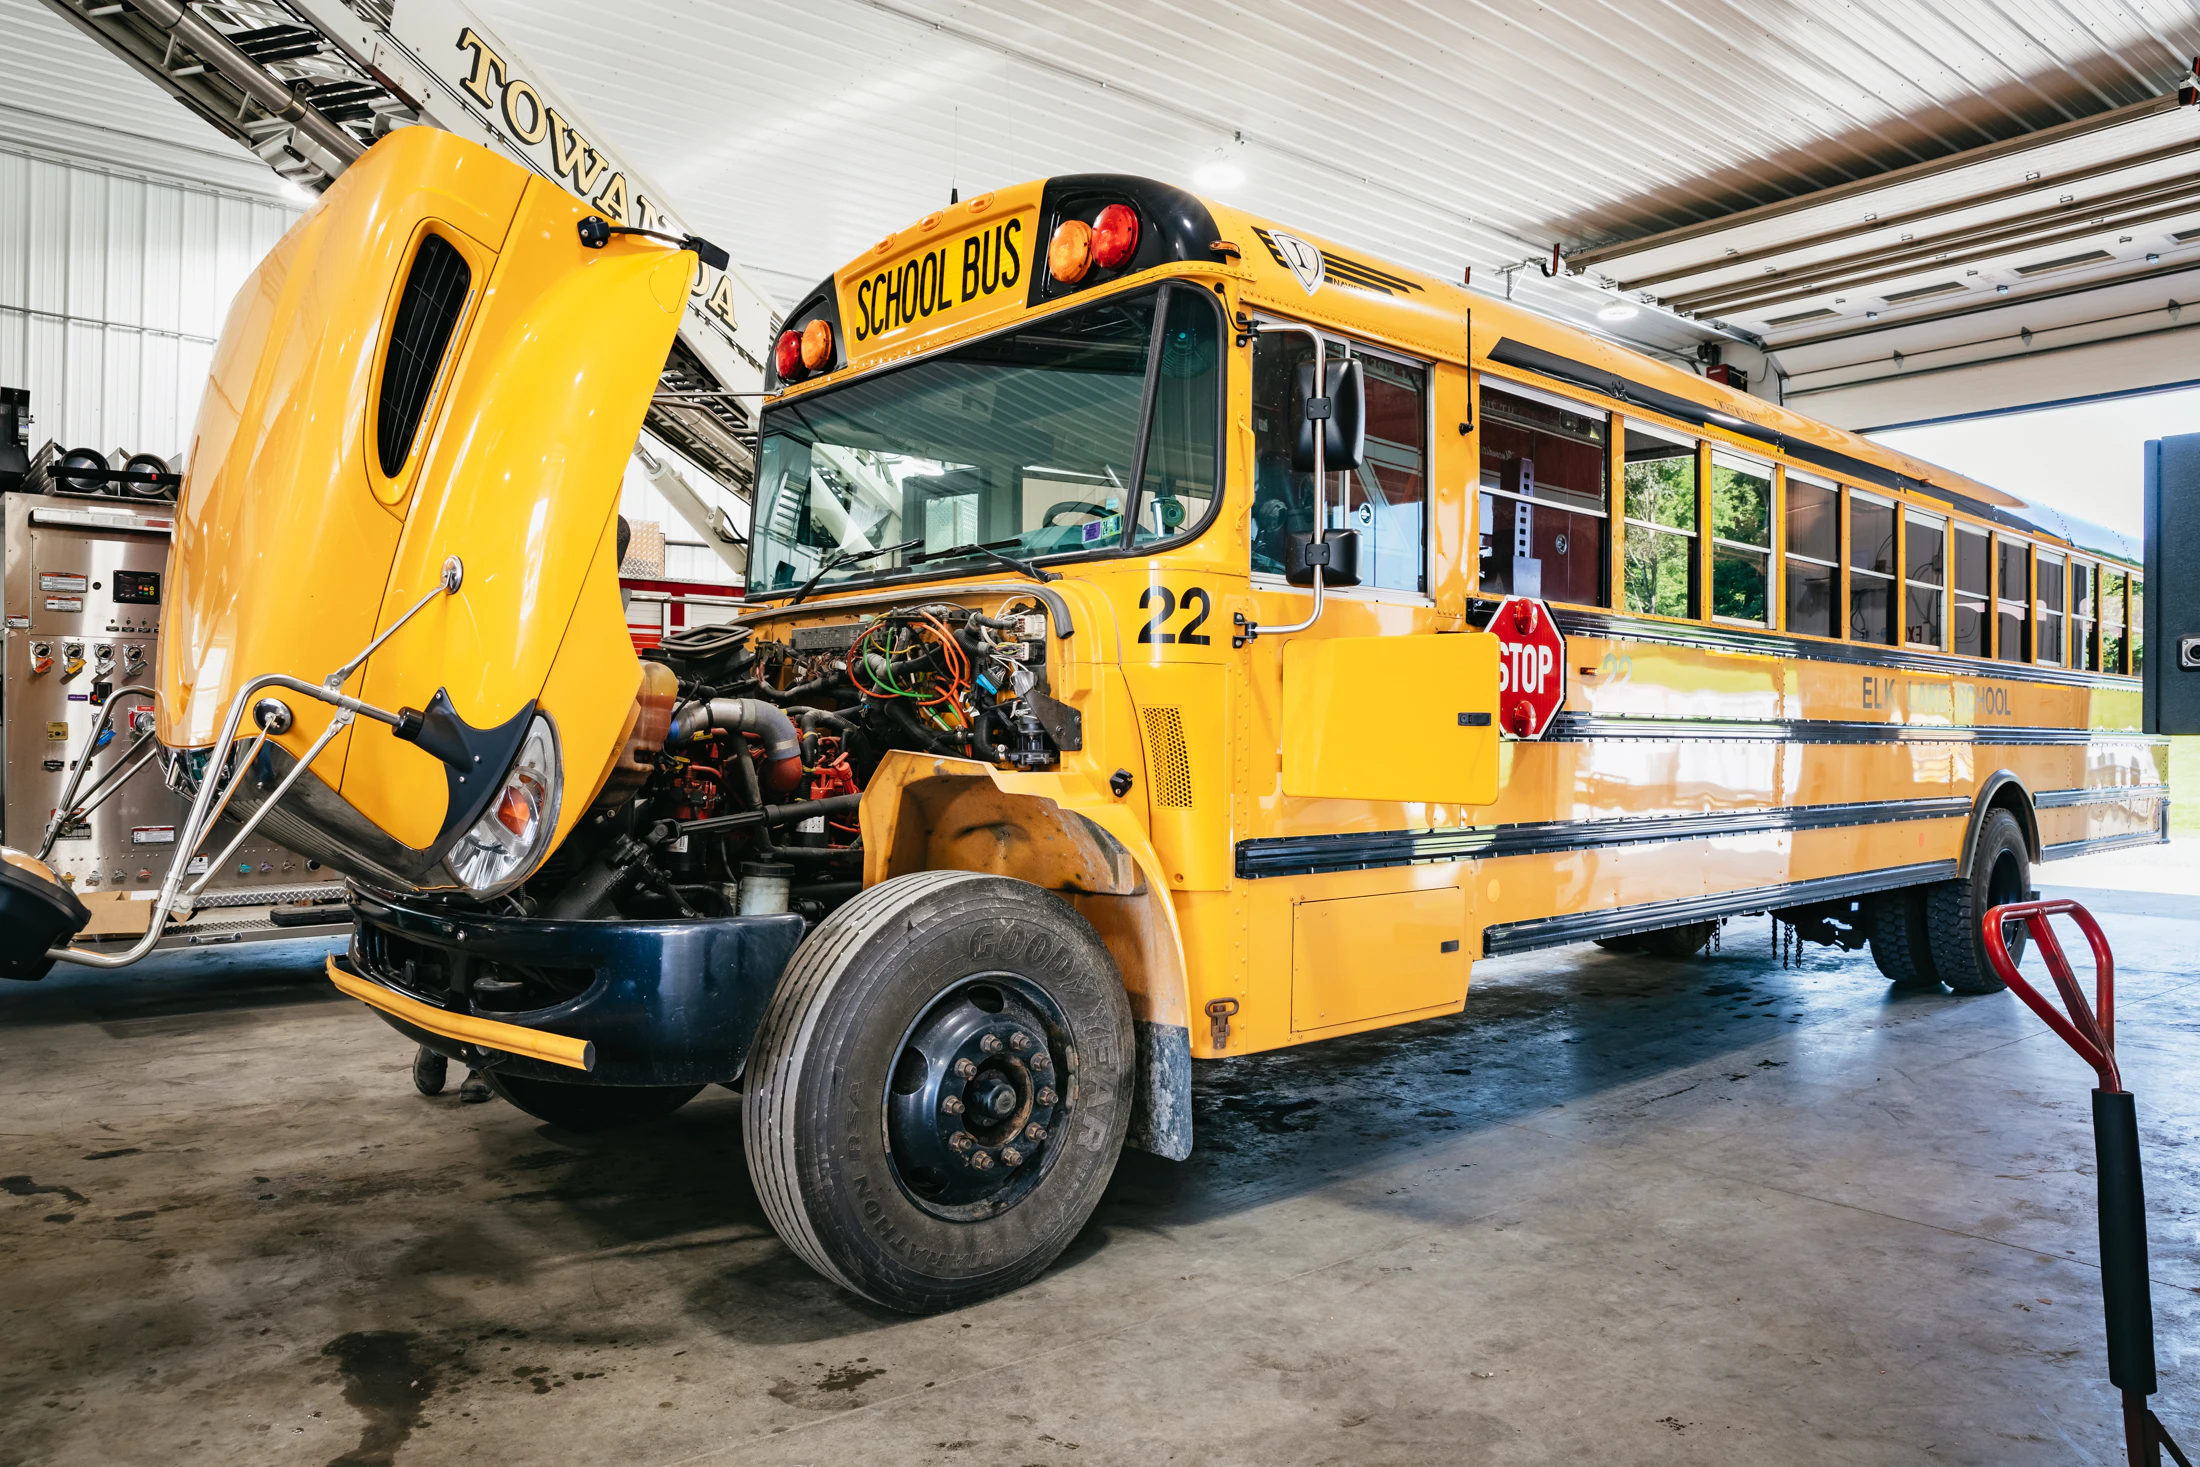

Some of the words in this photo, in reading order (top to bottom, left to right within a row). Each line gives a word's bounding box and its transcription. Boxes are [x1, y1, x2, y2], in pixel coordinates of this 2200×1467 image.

[856, 248, 952, 341] SCHOOL
[962, 218, 1021, 303] BUS
[1137, 585, 1211, 646] 22
[1500, 641, 1554, 694] STOP
[1603, 653, 1633, 691] 22
[1862, 676, 1895, 709] ELK
[1907, 680, 1950, 713] LAKE
[1957, 684, 2012, 716] SCHOOL
[853, 1175, 995, 1269] MARATHON
